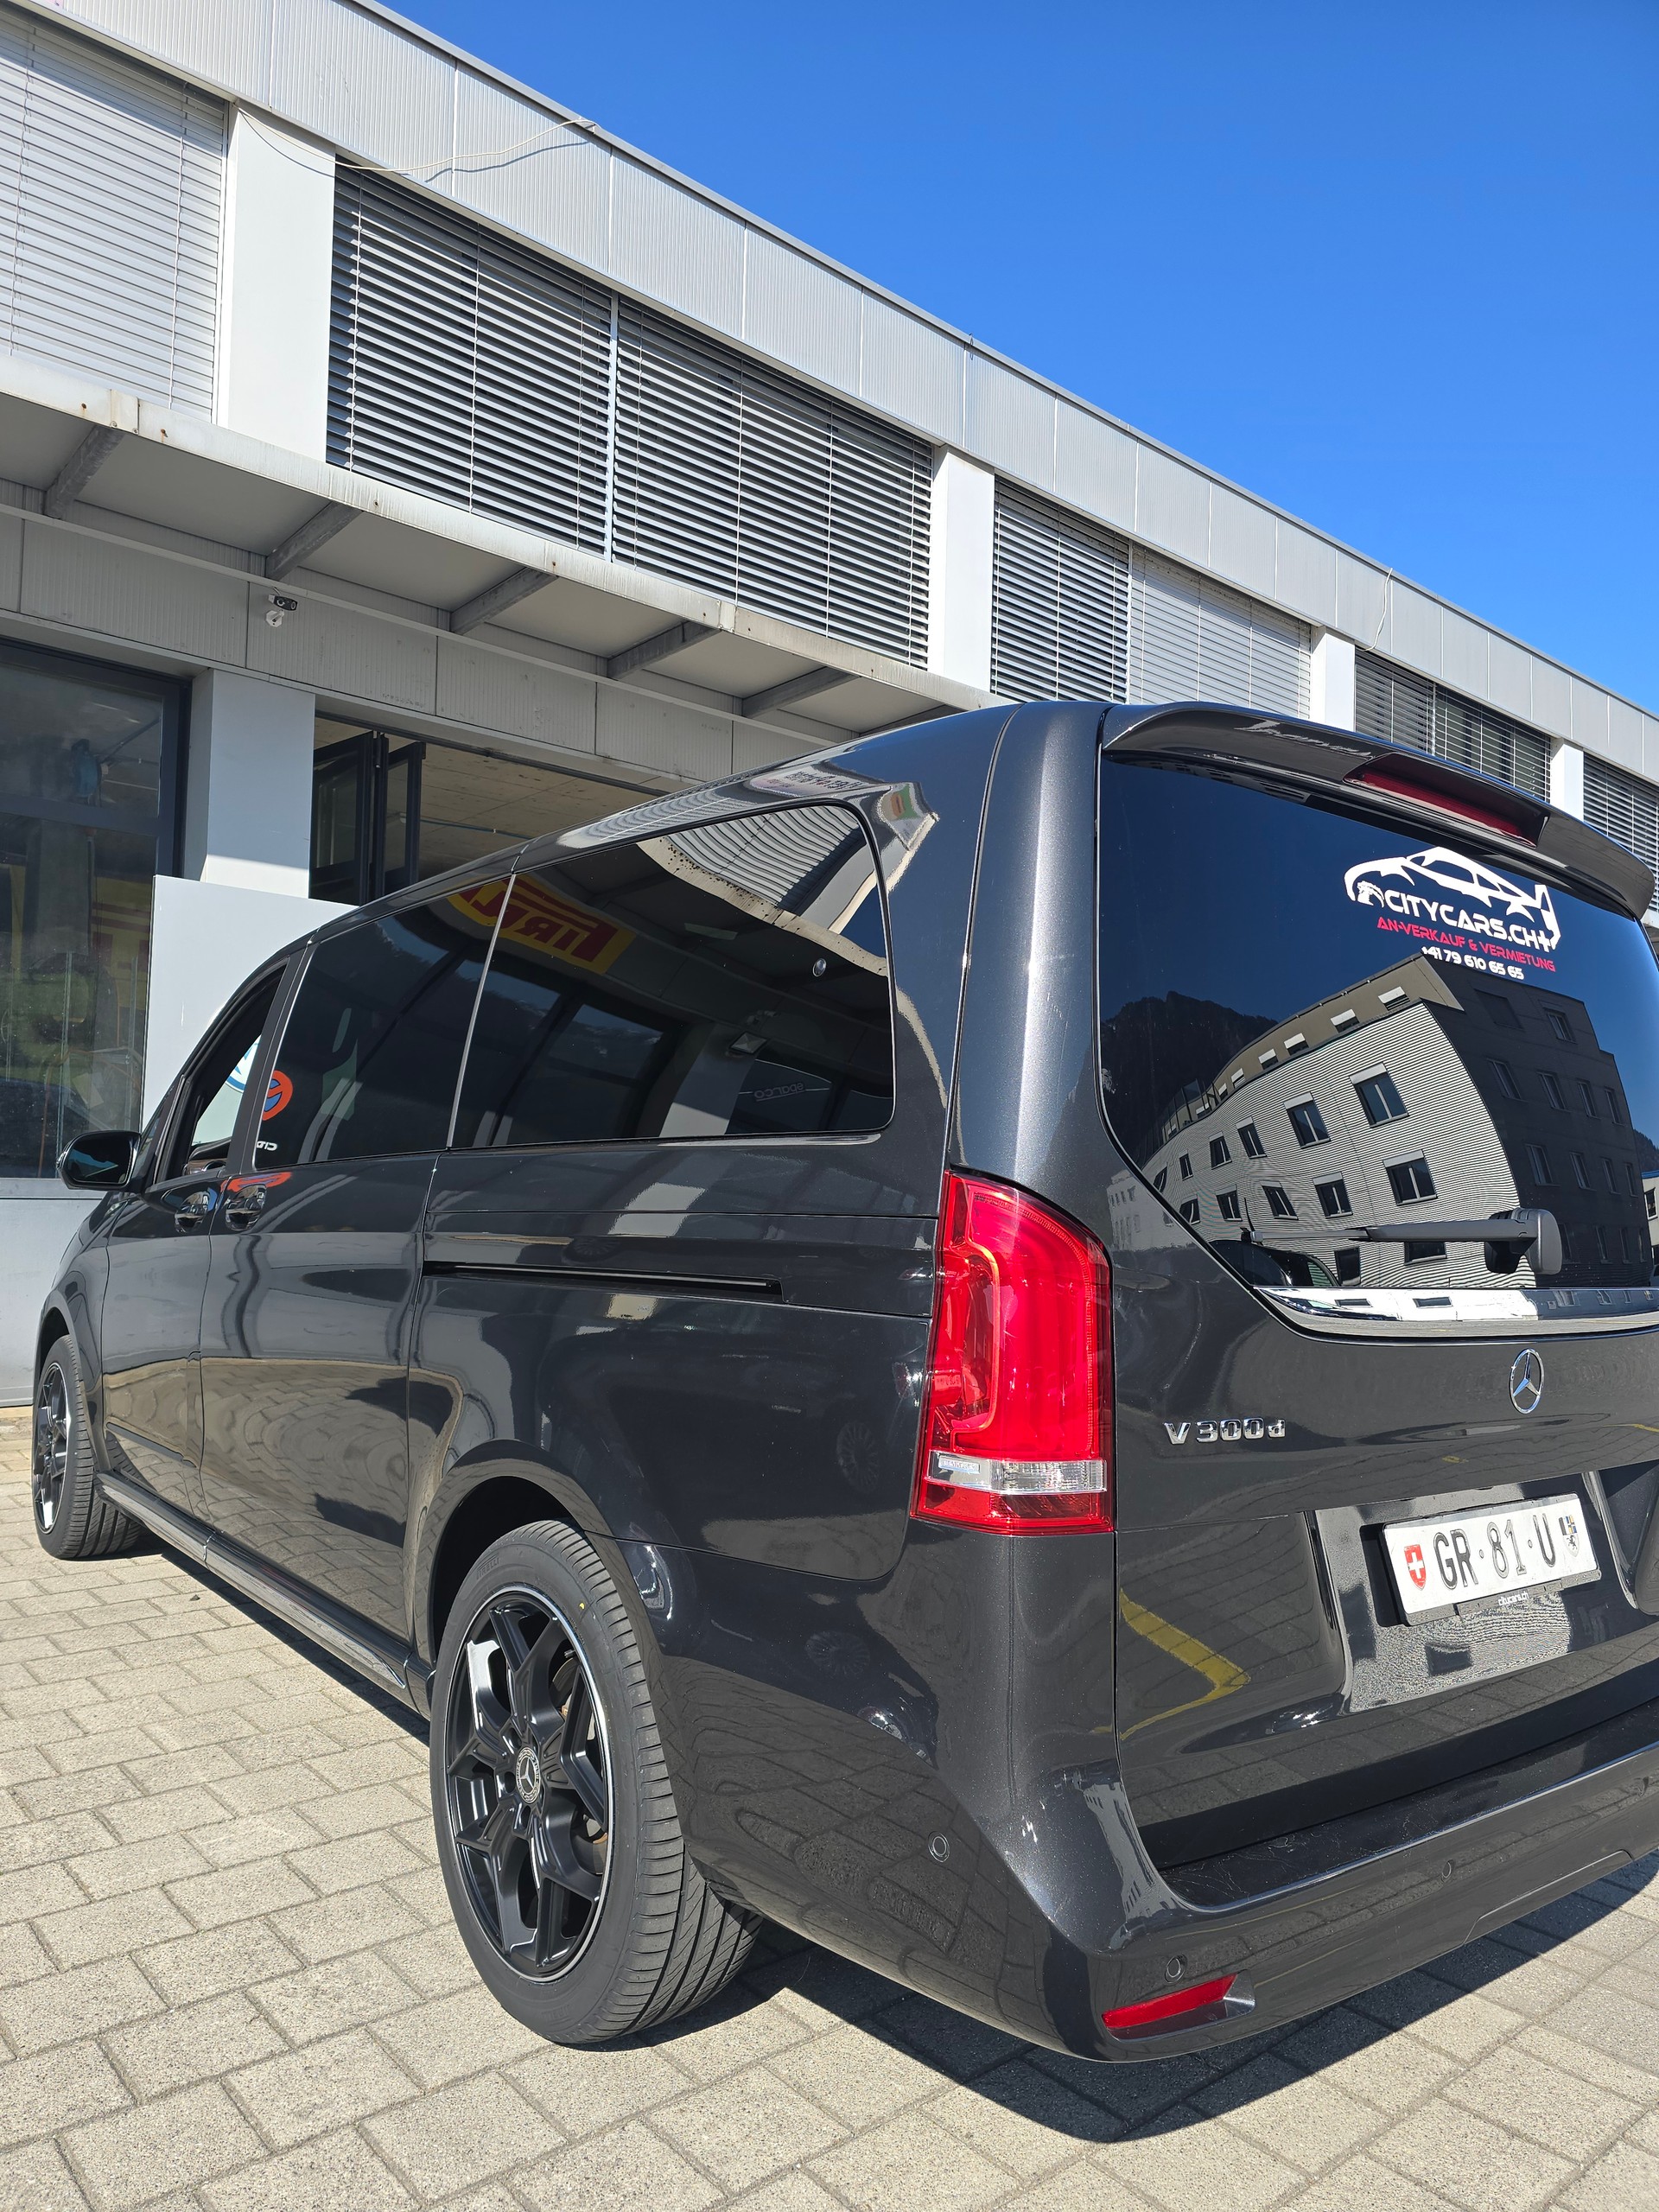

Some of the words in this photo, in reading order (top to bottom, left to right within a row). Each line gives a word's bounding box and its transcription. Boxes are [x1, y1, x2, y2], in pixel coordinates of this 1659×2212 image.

[1376, 916, 1465, 948] AN-VERKAUF
[1468, 938, 1478, 951] &
[1478, 942, 1556, 972] VERMIETUNG
[1443, 949, 1462, 964] 79
[1464, 955, 1487, 970] 610
[1488, 960, 1506, 976] 65
[1507, 965, 1525, 981] 65
